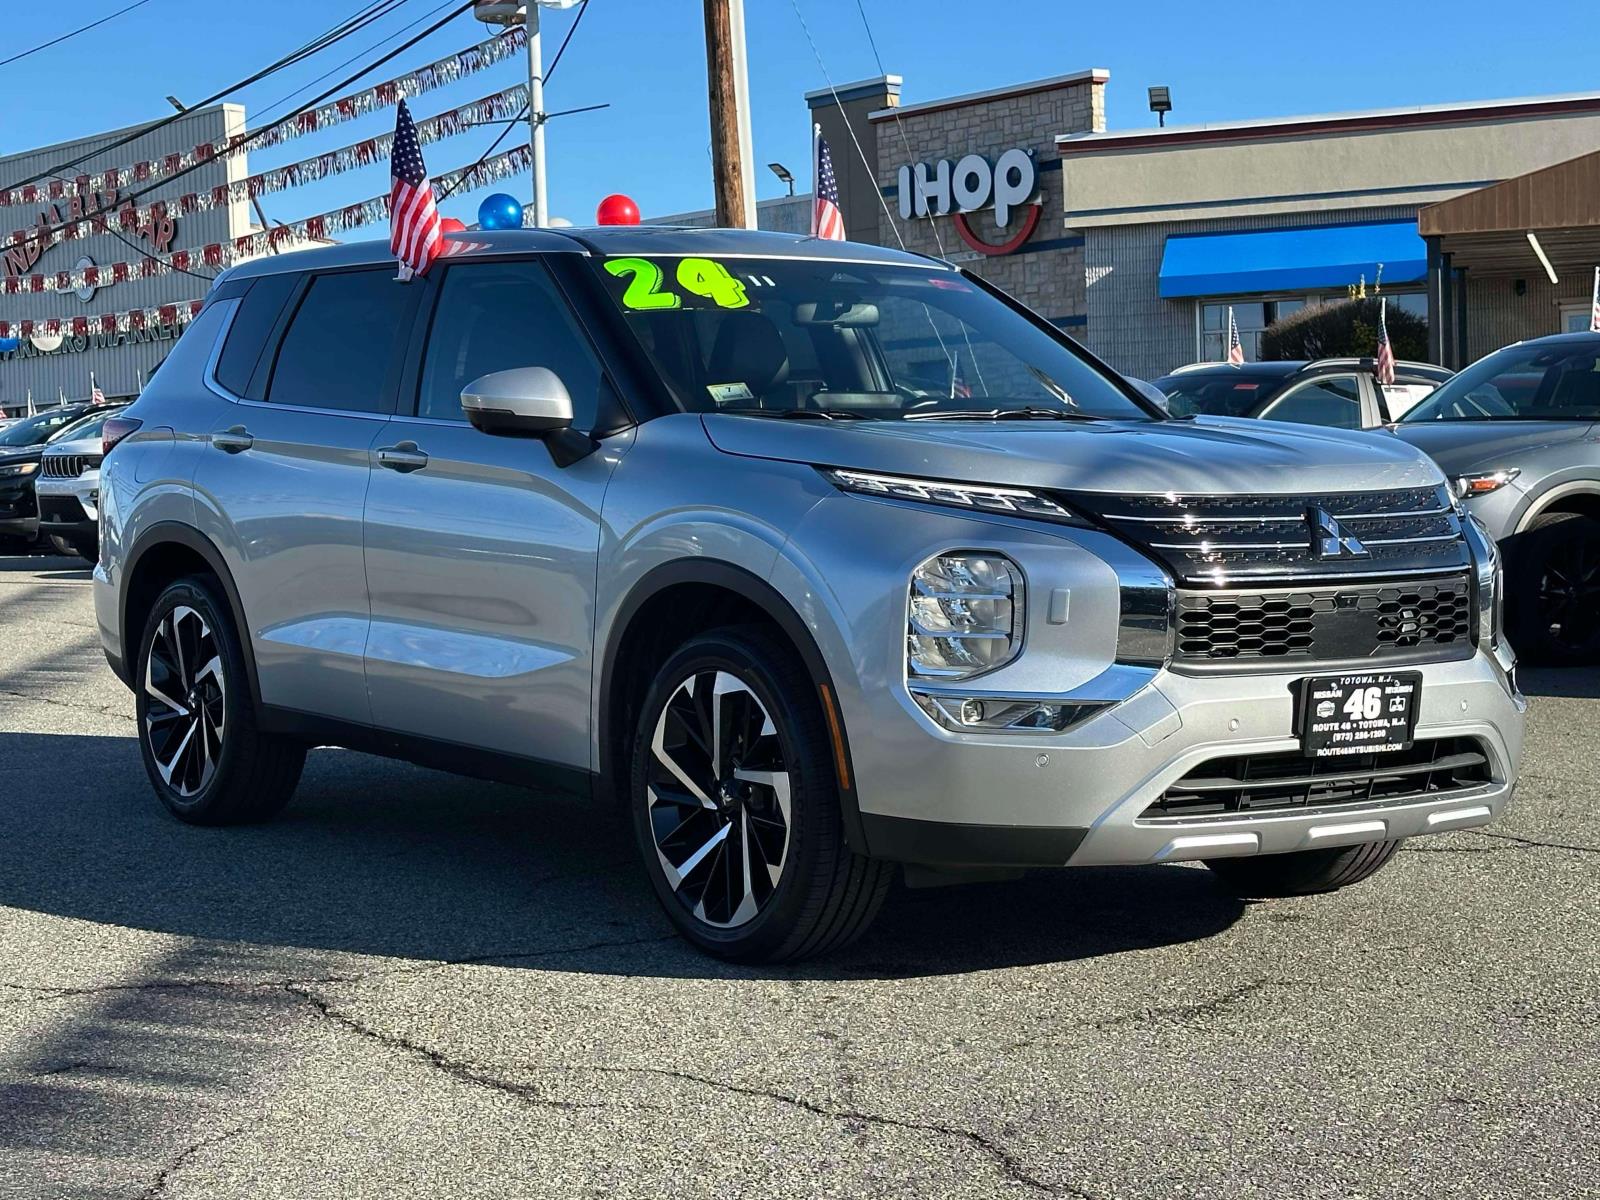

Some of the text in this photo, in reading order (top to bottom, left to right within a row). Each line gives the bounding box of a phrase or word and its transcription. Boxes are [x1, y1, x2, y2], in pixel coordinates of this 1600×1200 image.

[898, 148, 1034, 228] IHOP
[603, 257, 751, 310] 24
[1313, 690, 1343, 699] NISSAN
[1343, 686, 1382, 720] 46
[1312, 723, 1340, 732] ROUTE
[1340, 722, 1352, 730] 46
[1332, 732, 1353, 743] (973)
